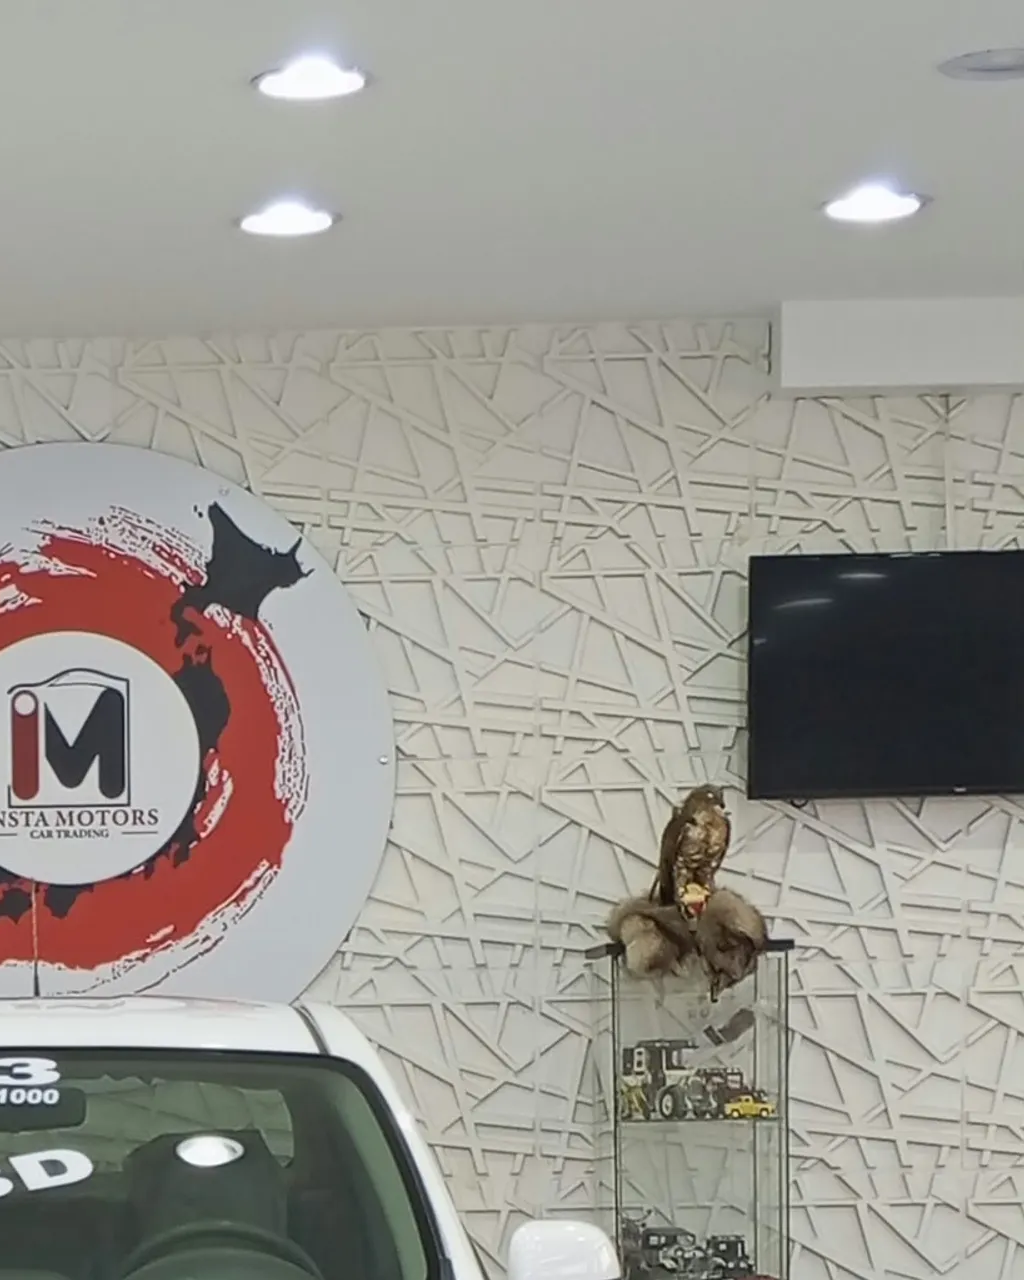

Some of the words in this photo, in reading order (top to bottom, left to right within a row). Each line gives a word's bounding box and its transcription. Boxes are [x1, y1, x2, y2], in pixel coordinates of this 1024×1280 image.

[55, 808, 160, 828] MOTORS
[29, 829, 54, 840] CAR
[56, 828, 110, 839] TRADING
